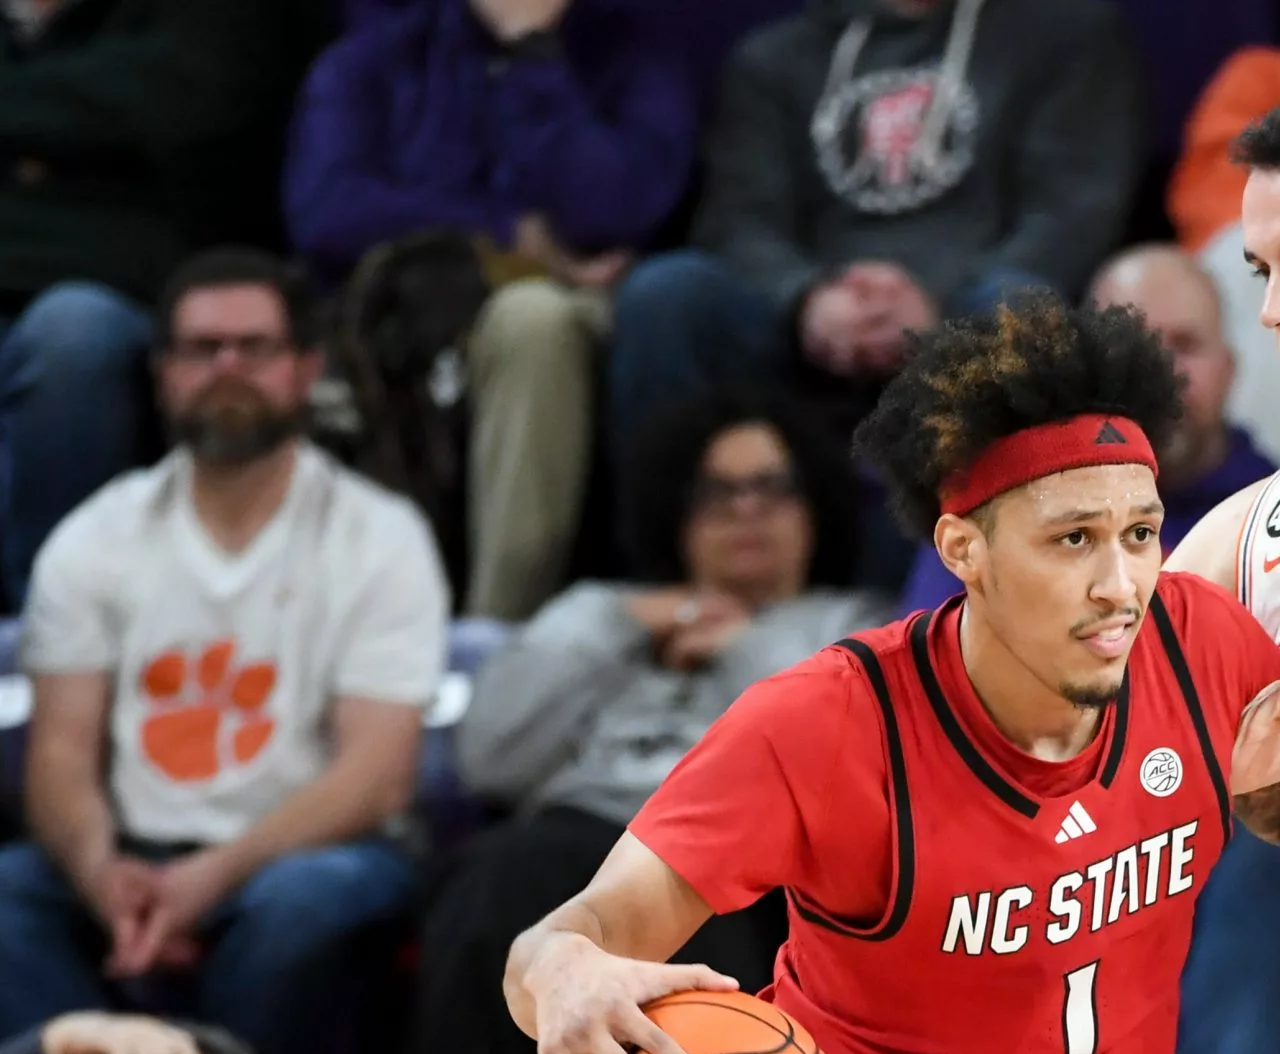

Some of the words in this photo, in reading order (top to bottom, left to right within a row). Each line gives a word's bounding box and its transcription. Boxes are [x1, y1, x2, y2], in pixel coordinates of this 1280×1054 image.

[1147, 760, 1176, 779] ACC
[942, 884, 1034, 956] NC
[1046, 818, 1199, 945] STATE
